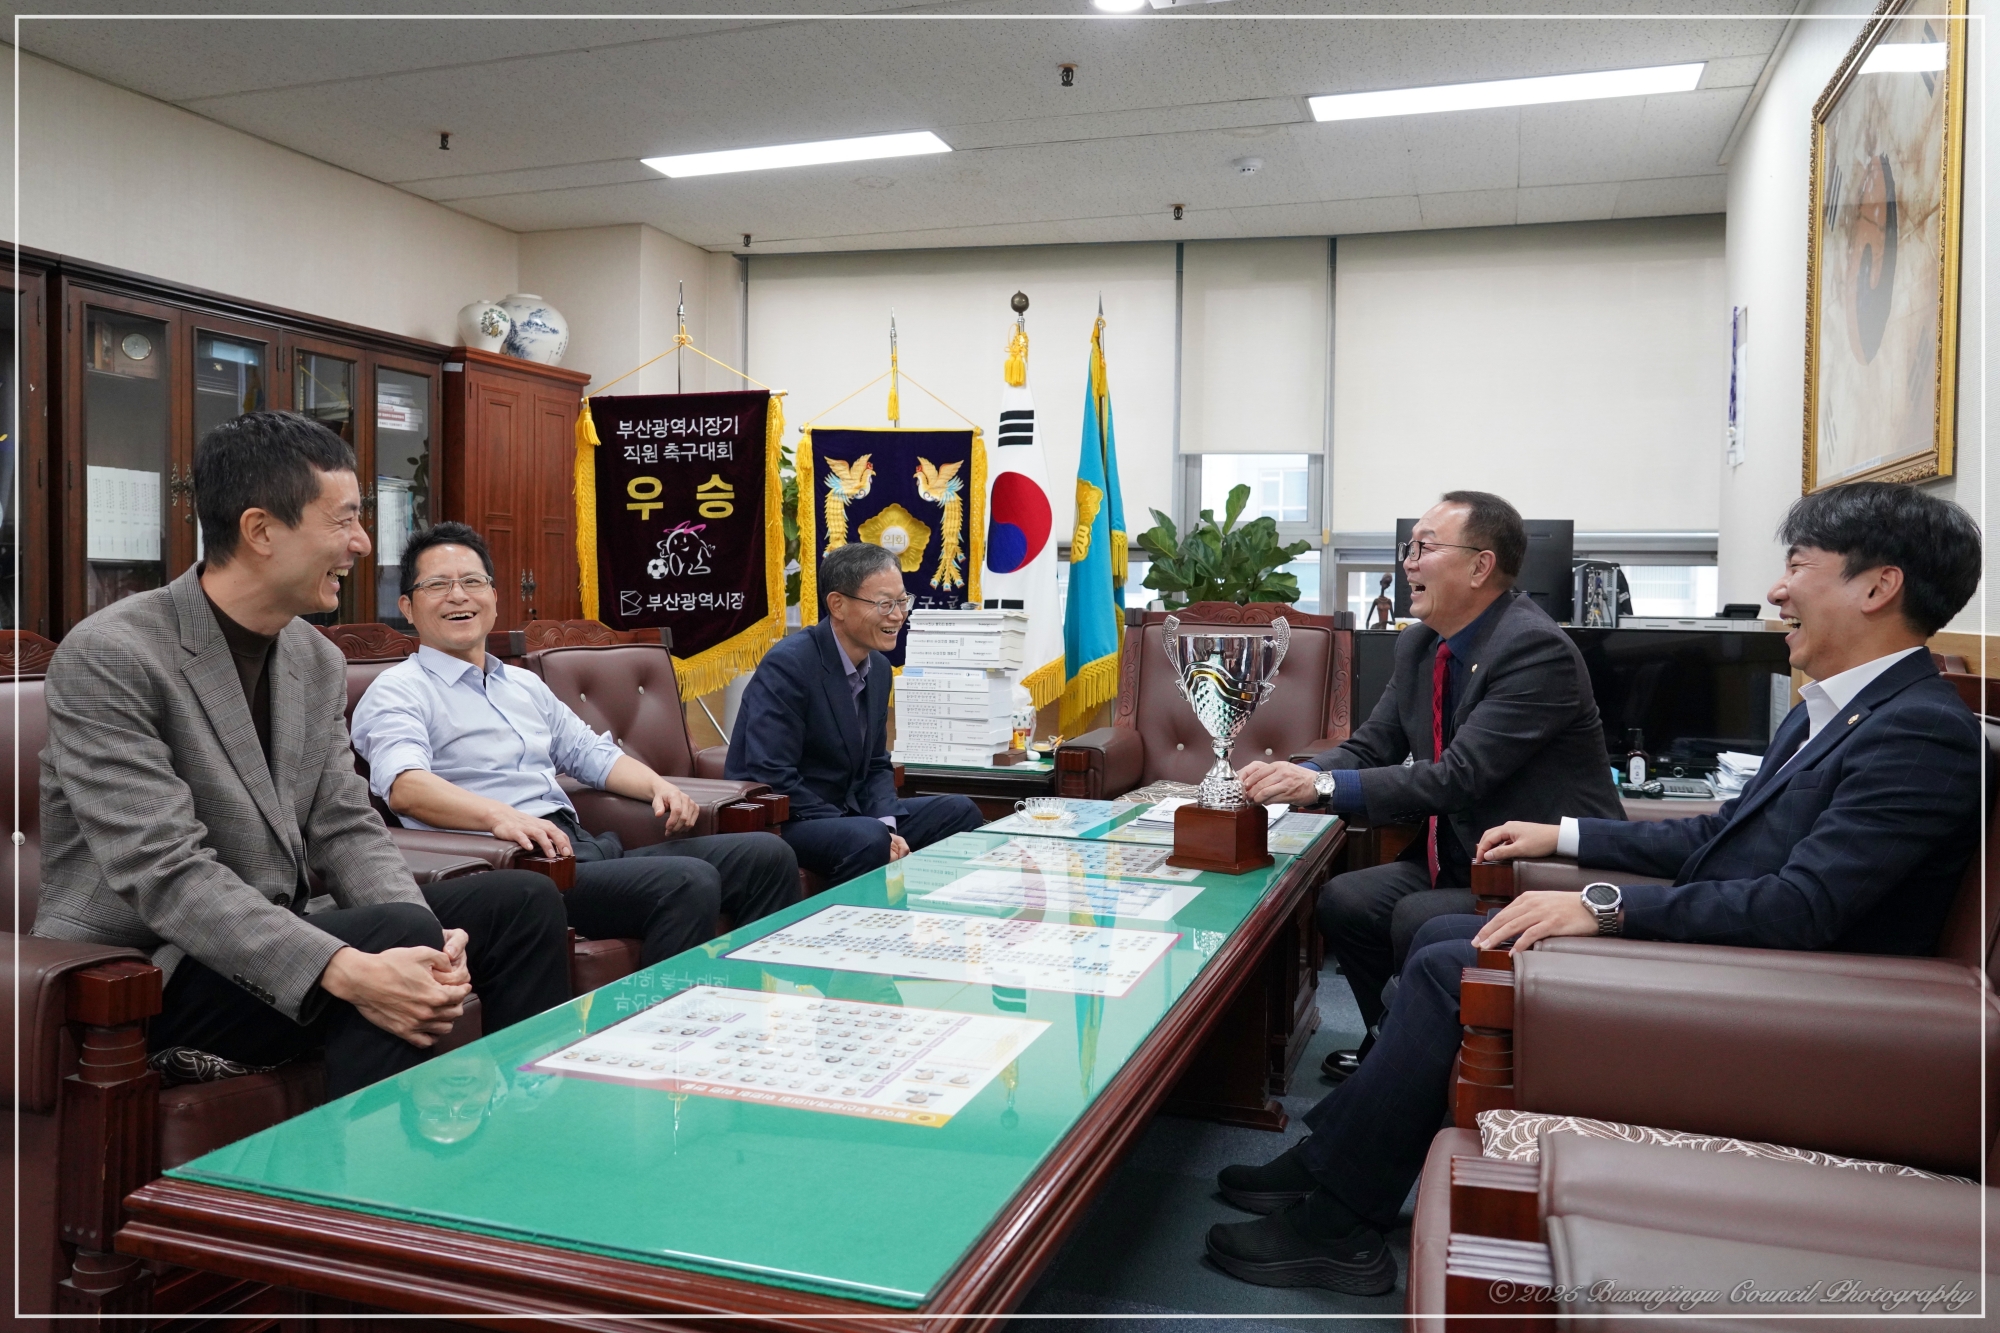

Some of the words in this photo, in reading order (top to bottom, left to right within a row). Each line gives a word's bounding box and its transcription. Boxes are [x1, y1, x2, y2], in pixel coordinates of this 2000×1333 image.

[616, 415, 740, 440] 부산광역시장기
[623, 443, 658, 465] 직원
[663, 440, 734, 463] 축구대회
[884, 533, 907, 547] 의회
[646, 592, 745, 612] 부산광역시장
